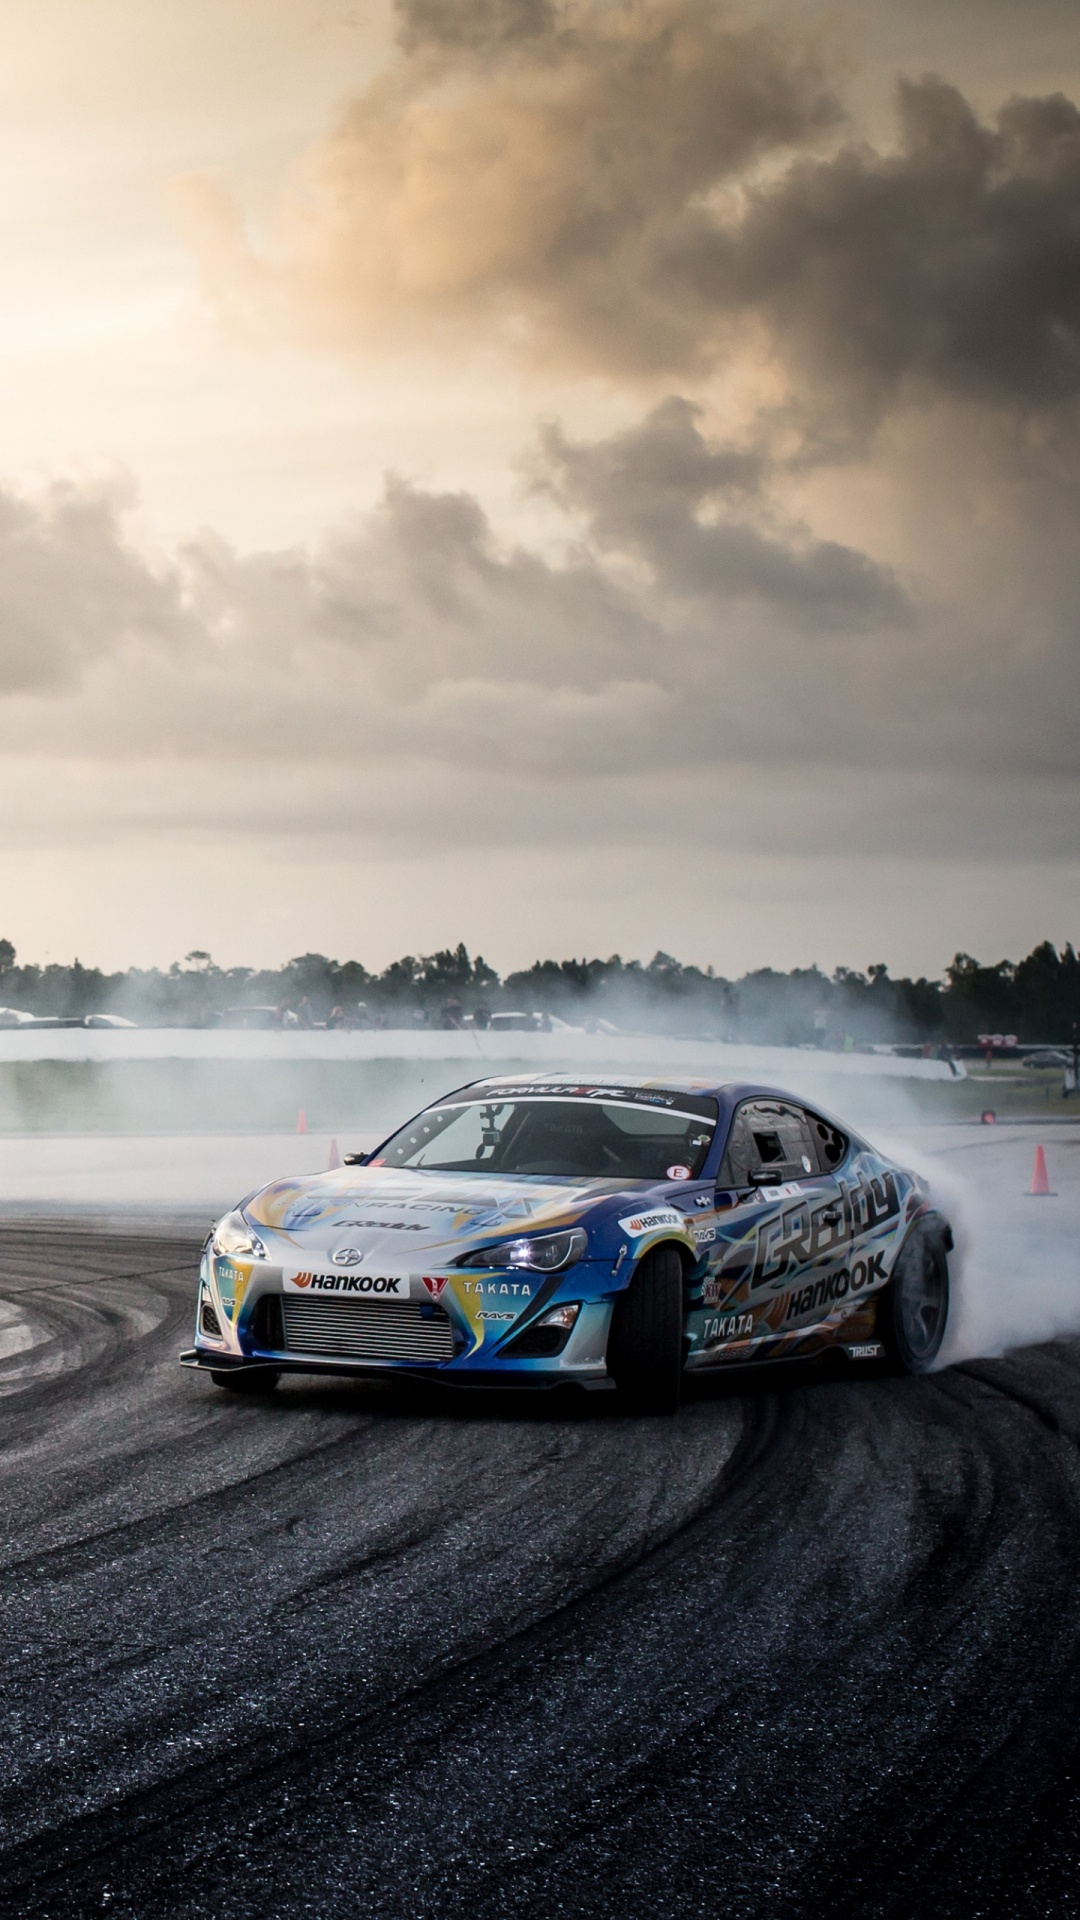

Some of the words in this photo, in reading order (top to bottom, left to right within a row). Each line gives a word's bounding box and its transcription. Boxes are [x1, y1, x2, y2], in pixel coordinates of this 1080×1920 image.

[463, 1282, 531, 1296] TAKATA
[476, 1311, 517, 1320] RAYS
[703, 1314, 754, 1339] TAKATA
[848, 1343, 881, 1358] TRUST
